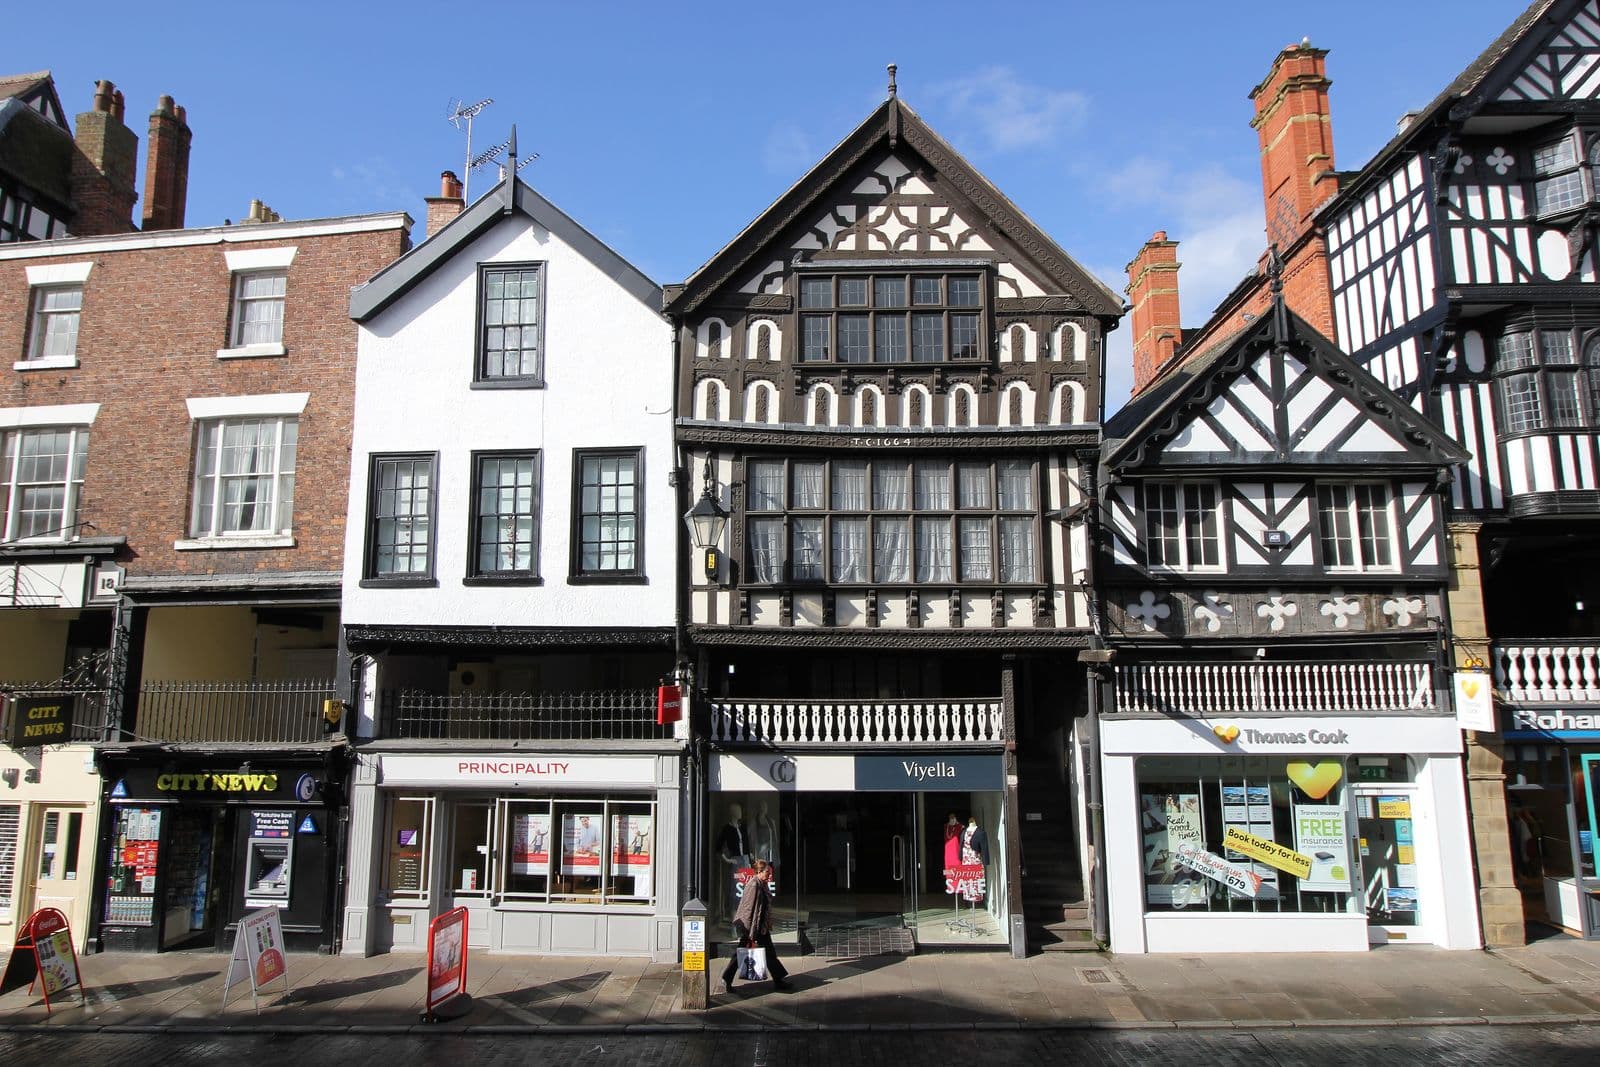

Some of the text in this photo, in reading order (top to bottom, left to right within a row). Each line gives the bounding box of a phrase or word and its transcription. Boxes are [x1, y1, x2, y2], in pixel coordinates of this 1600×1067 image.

[28, 705, 61, 719] CITY
[23, 722, 65, 737] NEWS
[1243, 728, 1349, 745] Thomas Cook
[458, 762, 570, 775] PRINCIPALITY
[902, 761, 955, 782] Viyella
[156, 773, 278, 792] CITY NEWS
[1166, 814, 1186, 825] Real
[1299, 818, 1344, 837] FREE
[1169, 820, 1194, 836] good
[1227, 828, 1250, 843] Book
[1251, 838, 1277, 855] today
[1277, 848, 1291, 859] for
[1292, 854, 1310, 867] less
[1300, 837, 1344, 846] insurance
[949, 867, 982, 880] Spring
[1194, 862, 1217, 877] TODAY
[735, 881, 776, 898] SE
[945, 878, 986, 894] SALE
